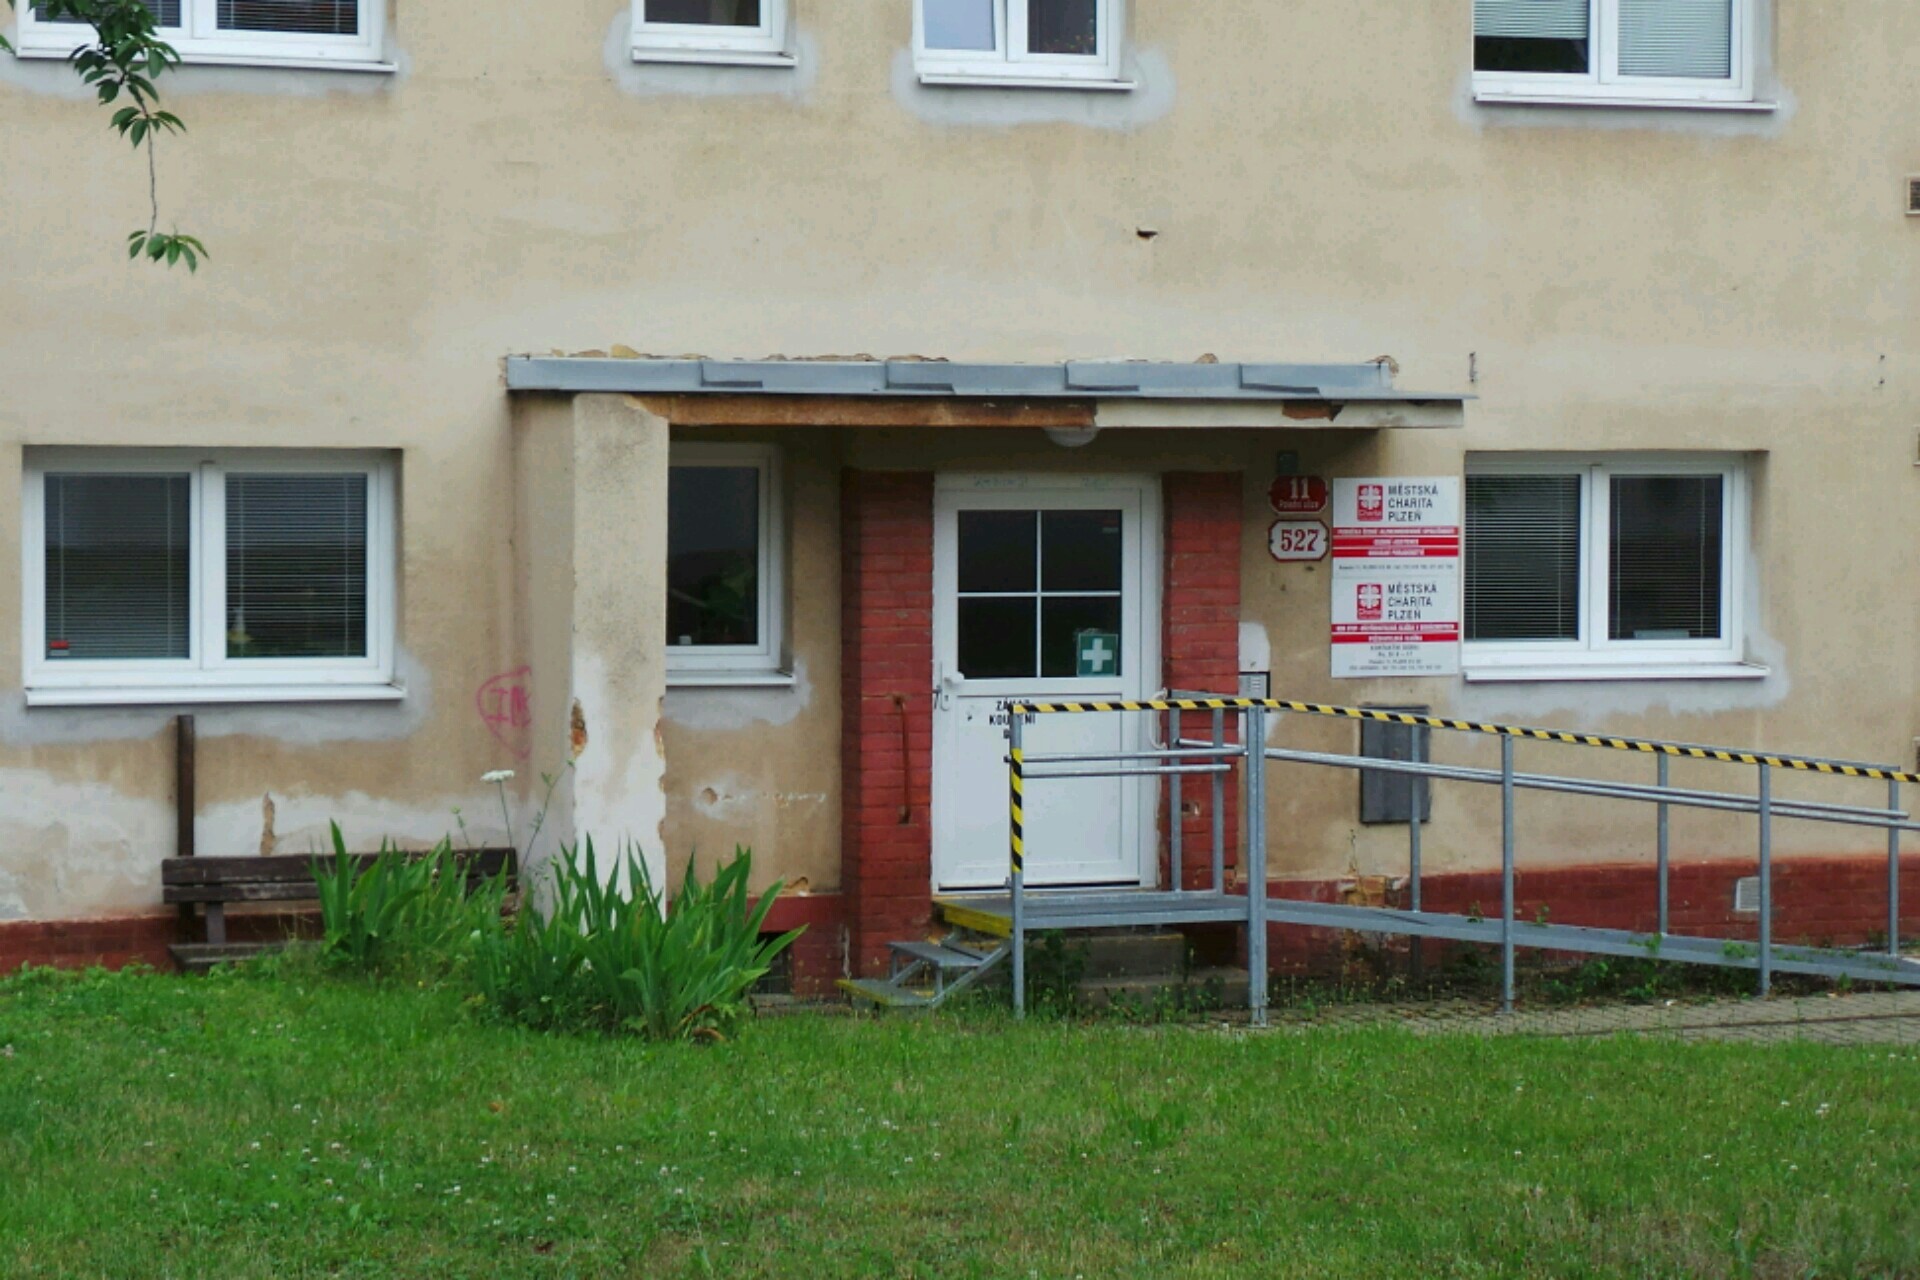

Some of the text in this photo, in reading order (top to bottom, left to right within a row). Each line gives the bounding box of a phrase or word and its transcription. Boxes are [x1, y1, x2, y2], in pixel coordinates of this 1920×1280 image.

[1290, 477, 1310, 499] 11
[1388, 482, 1438, 495] MĚSTSKÁ
[1388, 498, 1433, 509] CHARITA
[1388, 510, 1422, 522] PLZEŇ
[1281, 528, 1319, 552] 527
[1388, 582, 1437, 594] MĚSTSKÁ
[1388, 597, 1433, 608] CHARITA
